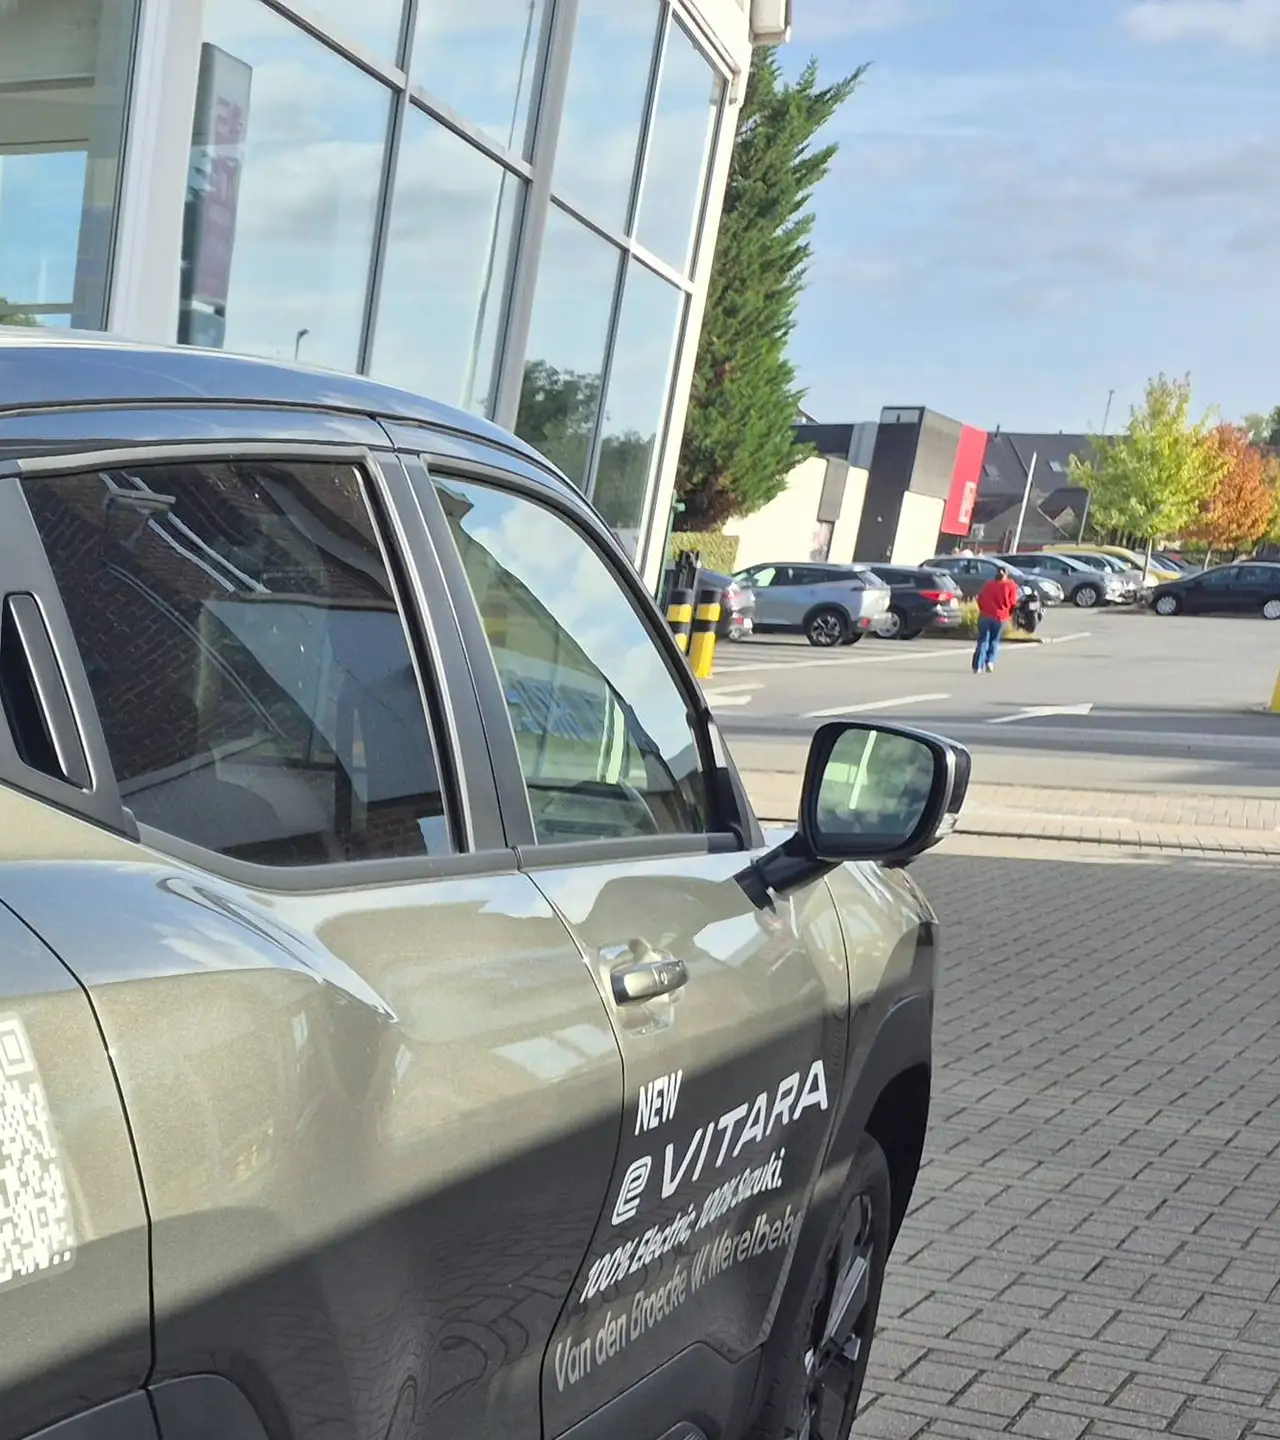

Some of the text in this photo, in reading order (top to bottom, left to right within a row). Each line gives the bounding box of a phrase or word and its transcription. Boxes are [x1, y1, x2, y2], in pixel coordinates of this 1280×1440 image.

[634, 1068, 683, 1136] NEW
[660, 1059, 829, 1200] VITARA
[554, 1336, 591, 1392] Van
[595, 1310, 627, 1366] den
[630, 1263, 688, 1342] Broecke
[691, 1243, 711, 1294] W.
